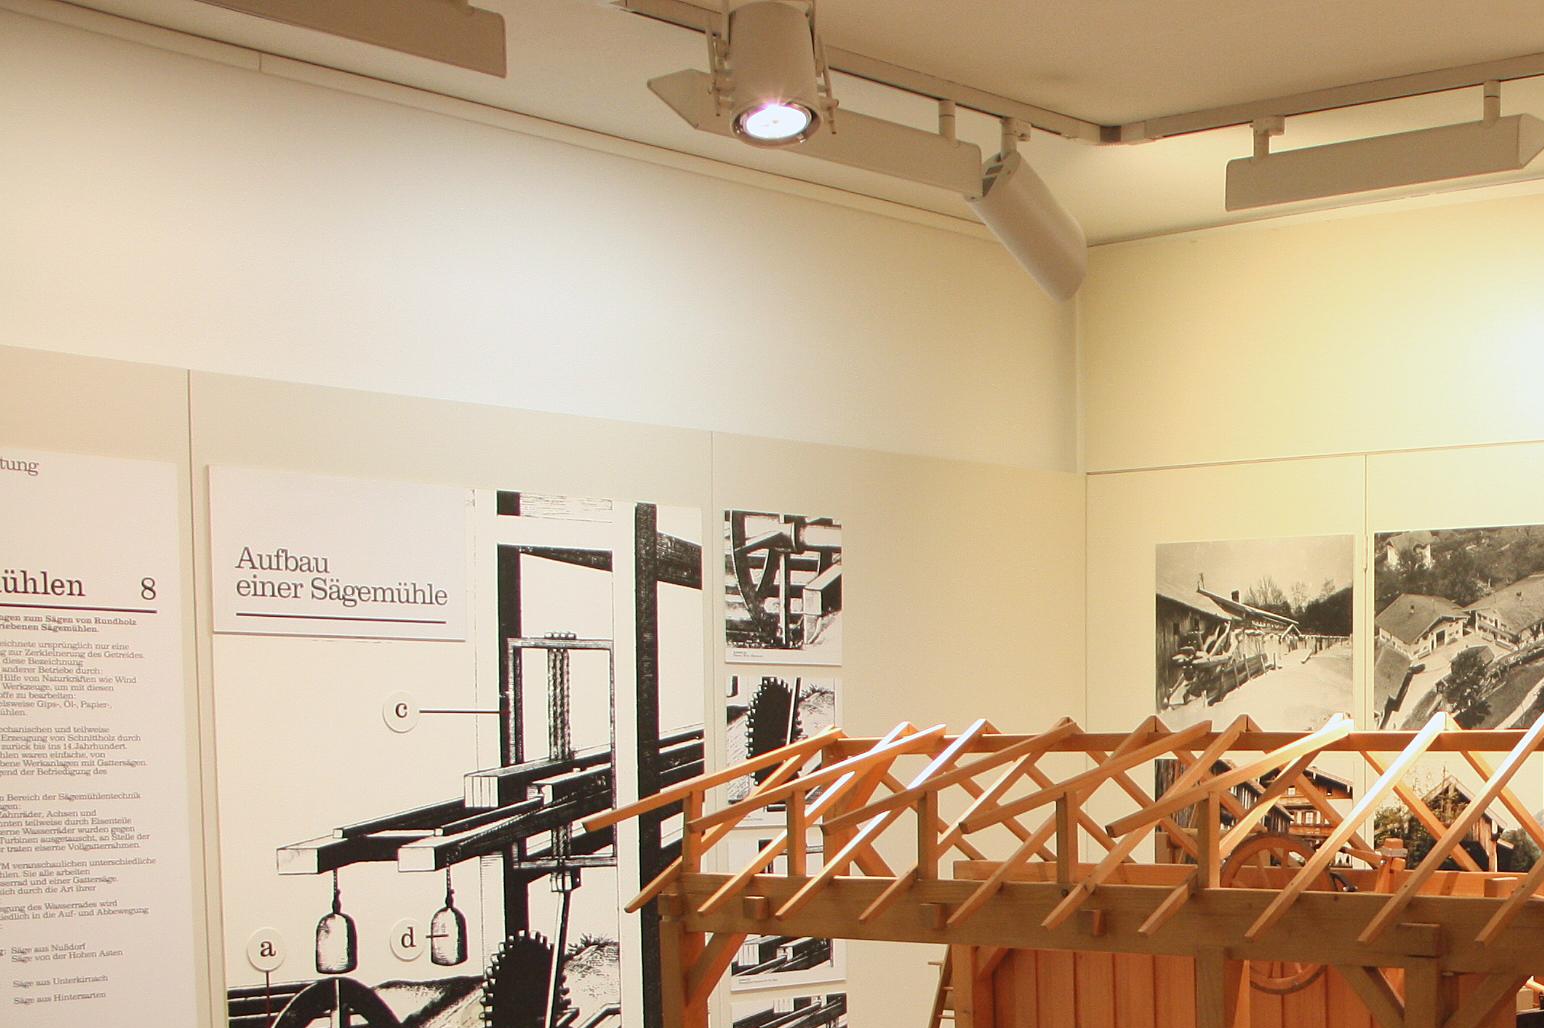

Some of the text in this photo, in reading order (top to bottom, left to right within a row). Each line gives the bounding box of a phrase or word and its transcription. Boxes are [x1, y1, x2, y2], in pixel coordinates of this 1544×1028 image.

[235, 547, 329, 573] Aufbau
[140, 577, 157, 600] 8
[236, 575, 448, 607] einer Sägemühle
[94, 616, 137, 625] Rundholz
[28, 658, 83, 667] Bezeichnung
[115, 676, 137, 684] Wind
[394, 702, 408, 718] c
[46, 809, 97, 818] Achsen und
[77, 826, 109, 834] wurden
[23, 870, 37, 878] Sie
[30, 878, 47, 886] und
[18, 887, 43, 895] durch
[27, 903, 42, 911] des
[78, 909, 94, 917] und
[400, 926, 416, 948] d
[51, 943, 86, 952] Nußdorf
[260, 939, 276, 957] a
